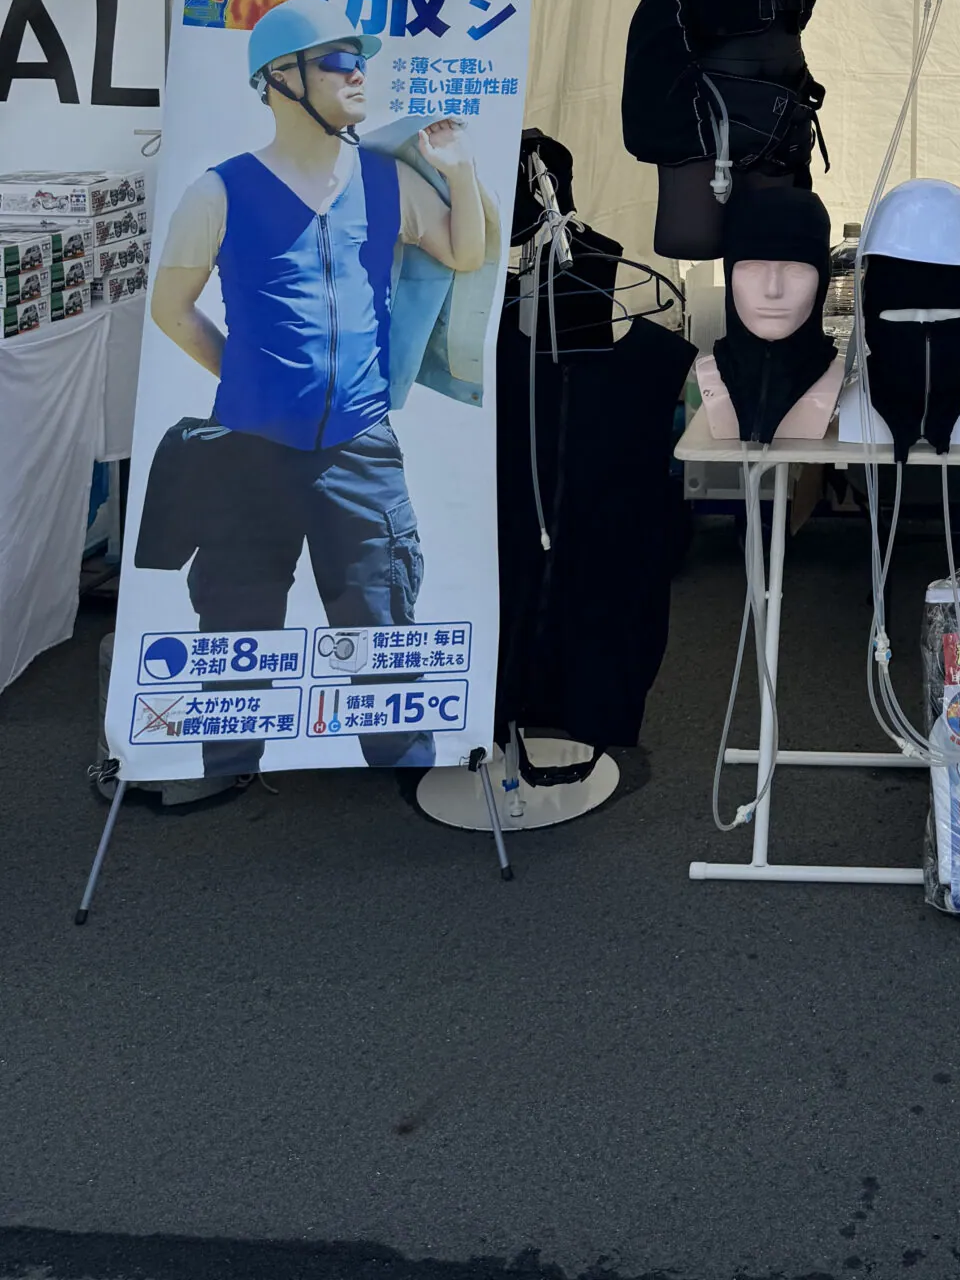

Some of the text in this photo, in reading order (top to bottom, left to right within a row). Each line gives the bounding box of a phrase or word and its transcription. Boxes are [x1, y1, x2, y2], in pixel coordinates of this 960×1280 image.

[409, 57, 494, 74] 薄くて軽い
[409, 78, 518, 95] 高い運動性能
[407, 98, 481, 116] 長い実績
[191, 637, 229, 656] 連続
[434, 630, 466, 648] 毎日
[189, 658, 227, 676] 冷却
[371, 651, 465, 670] 洗濯機で洗える
[185, 696, 262, 715] 大がかりな
[347, 694, 376, 710] 循環
[182, 715, 294, 736] 設備投資不要
[345, 711, 388, 727] 水温約
